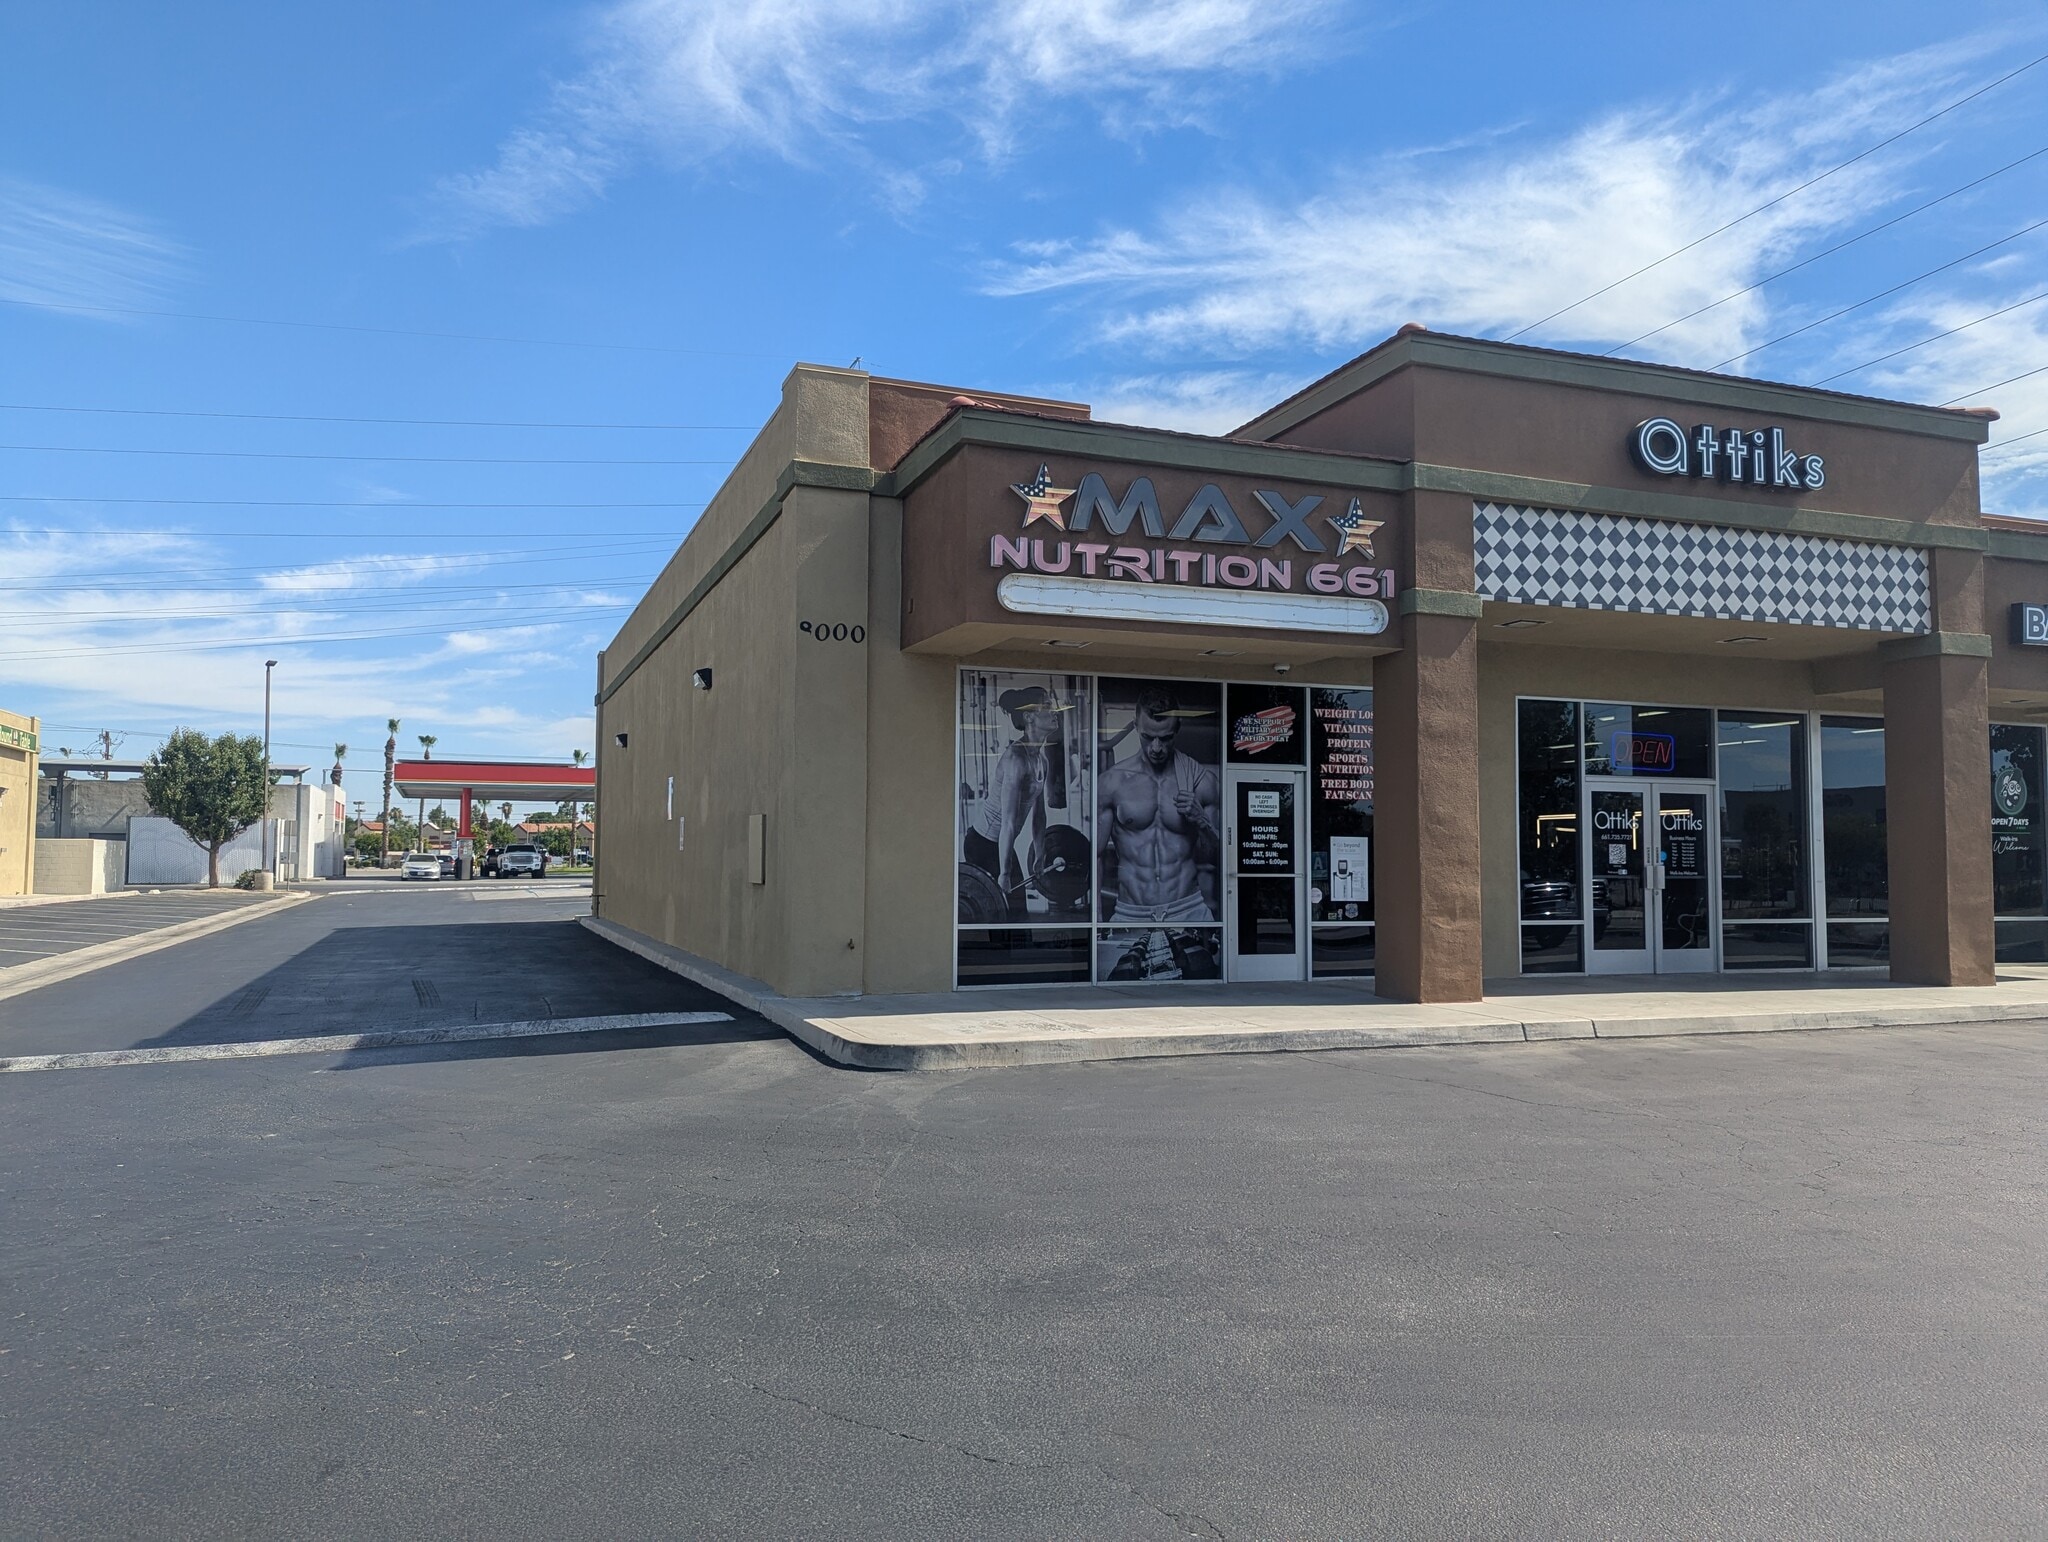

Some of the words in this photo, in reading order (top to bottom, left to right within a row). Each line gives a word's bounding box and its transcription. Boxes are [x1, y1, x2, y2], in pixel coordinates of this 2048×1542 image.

[1068, 471, 1328, 552] MAX
[990, 534, 1292, 590] NUTRITION
[1306, 563, 1396, 598] 661
[2026, 606, 2048, 641] B
[1314, 708, 1357, 719] WEIGHT
[1323, 723, 1374, 734] VITAMINS
[1327, 738, 1371, 748] PROTEIN
[1615, 740, 1672, 764] OPEN
[1328, 753, 1368, 763] SPORTS
[1321, 779, 1348, 789] FREE
[1325, 790, 1345, 800] FAT
[1346, 790, 1372, 800] SCAN
[1991, 818, 2008, 826] OPEN
[2008, 817, 2014, 827] 7
[2013, 818, 2029, 826] DAYS
[1993, 840, 2029, 854] Welcome
[1314, 857, 1323, 870] A
